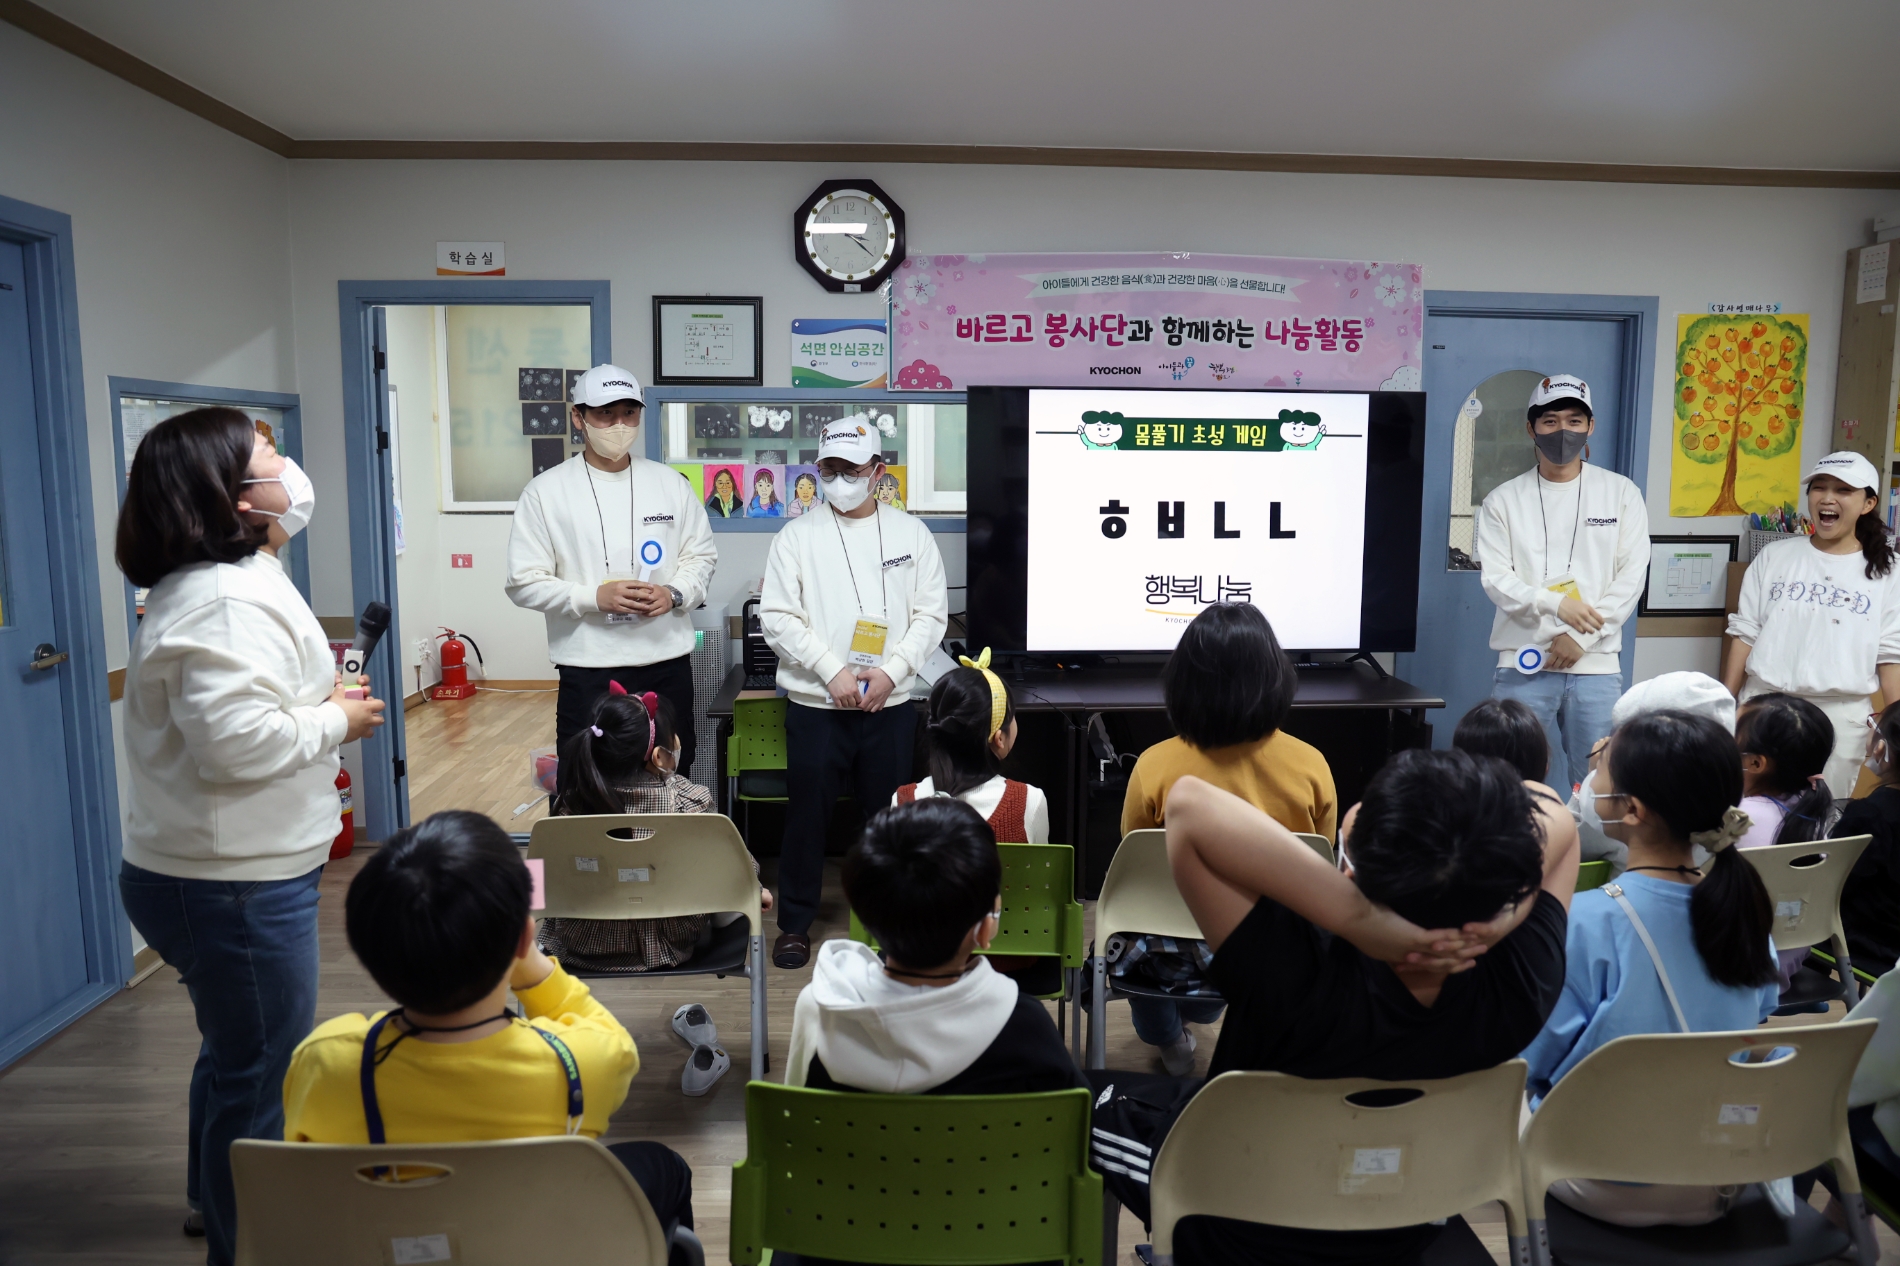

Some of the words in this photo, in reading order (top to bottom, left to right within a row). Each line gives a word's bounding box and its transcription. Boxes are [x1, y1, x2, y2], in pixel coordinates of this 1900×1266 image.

[833, 205, 840, 215] 11
[846, 202, 855, 212] 12
[872, 216, 878, 226] 2
[449, 252, 493, 266] 학습실
[1042, 276, 1089, 290] 아이들에게
[1091, 275, 1119, 286] 건강한
[1121, 274, 1166, 285] 음식(食)과
[1167, 274, 1196, 285] 건강한
[1198, 275, 1238, 289] 마음(心)을
[1240, 278, 1286, 295] 선물합니다!
[956, 314, 1034, 343] 바르고
[1045, 313, 1154, 348] 봉사단과
[1162, 316, 1255, 349] 함께하는
[1265, 317, 1364, 353] 나눔활동
[800, 343, 826, 356] 석면
[830, 343, 885, 357] 안심공간
[1090, 366, 1142, 375] KYOCHON
[1158, 362, 1185, 372] 아이들과
[603, 380, 634, 389] KYOCHON
[1550, 382, 1581, 391] KYOCHON
[826, 433, 858, 441] KYOCHON
[1135, 424, 1185, 446] 몸풀기
[1192, 424, 1225, 446] 초성
[1232, 425, 1267, 447] 게임
[643, 515, 674, 523] KYOCHON
[882, 554, 912, 568] KYOCHON
[1145, 574, 1252, 605] 행복나눔
[1769, 581, 1871, 615] BORED
